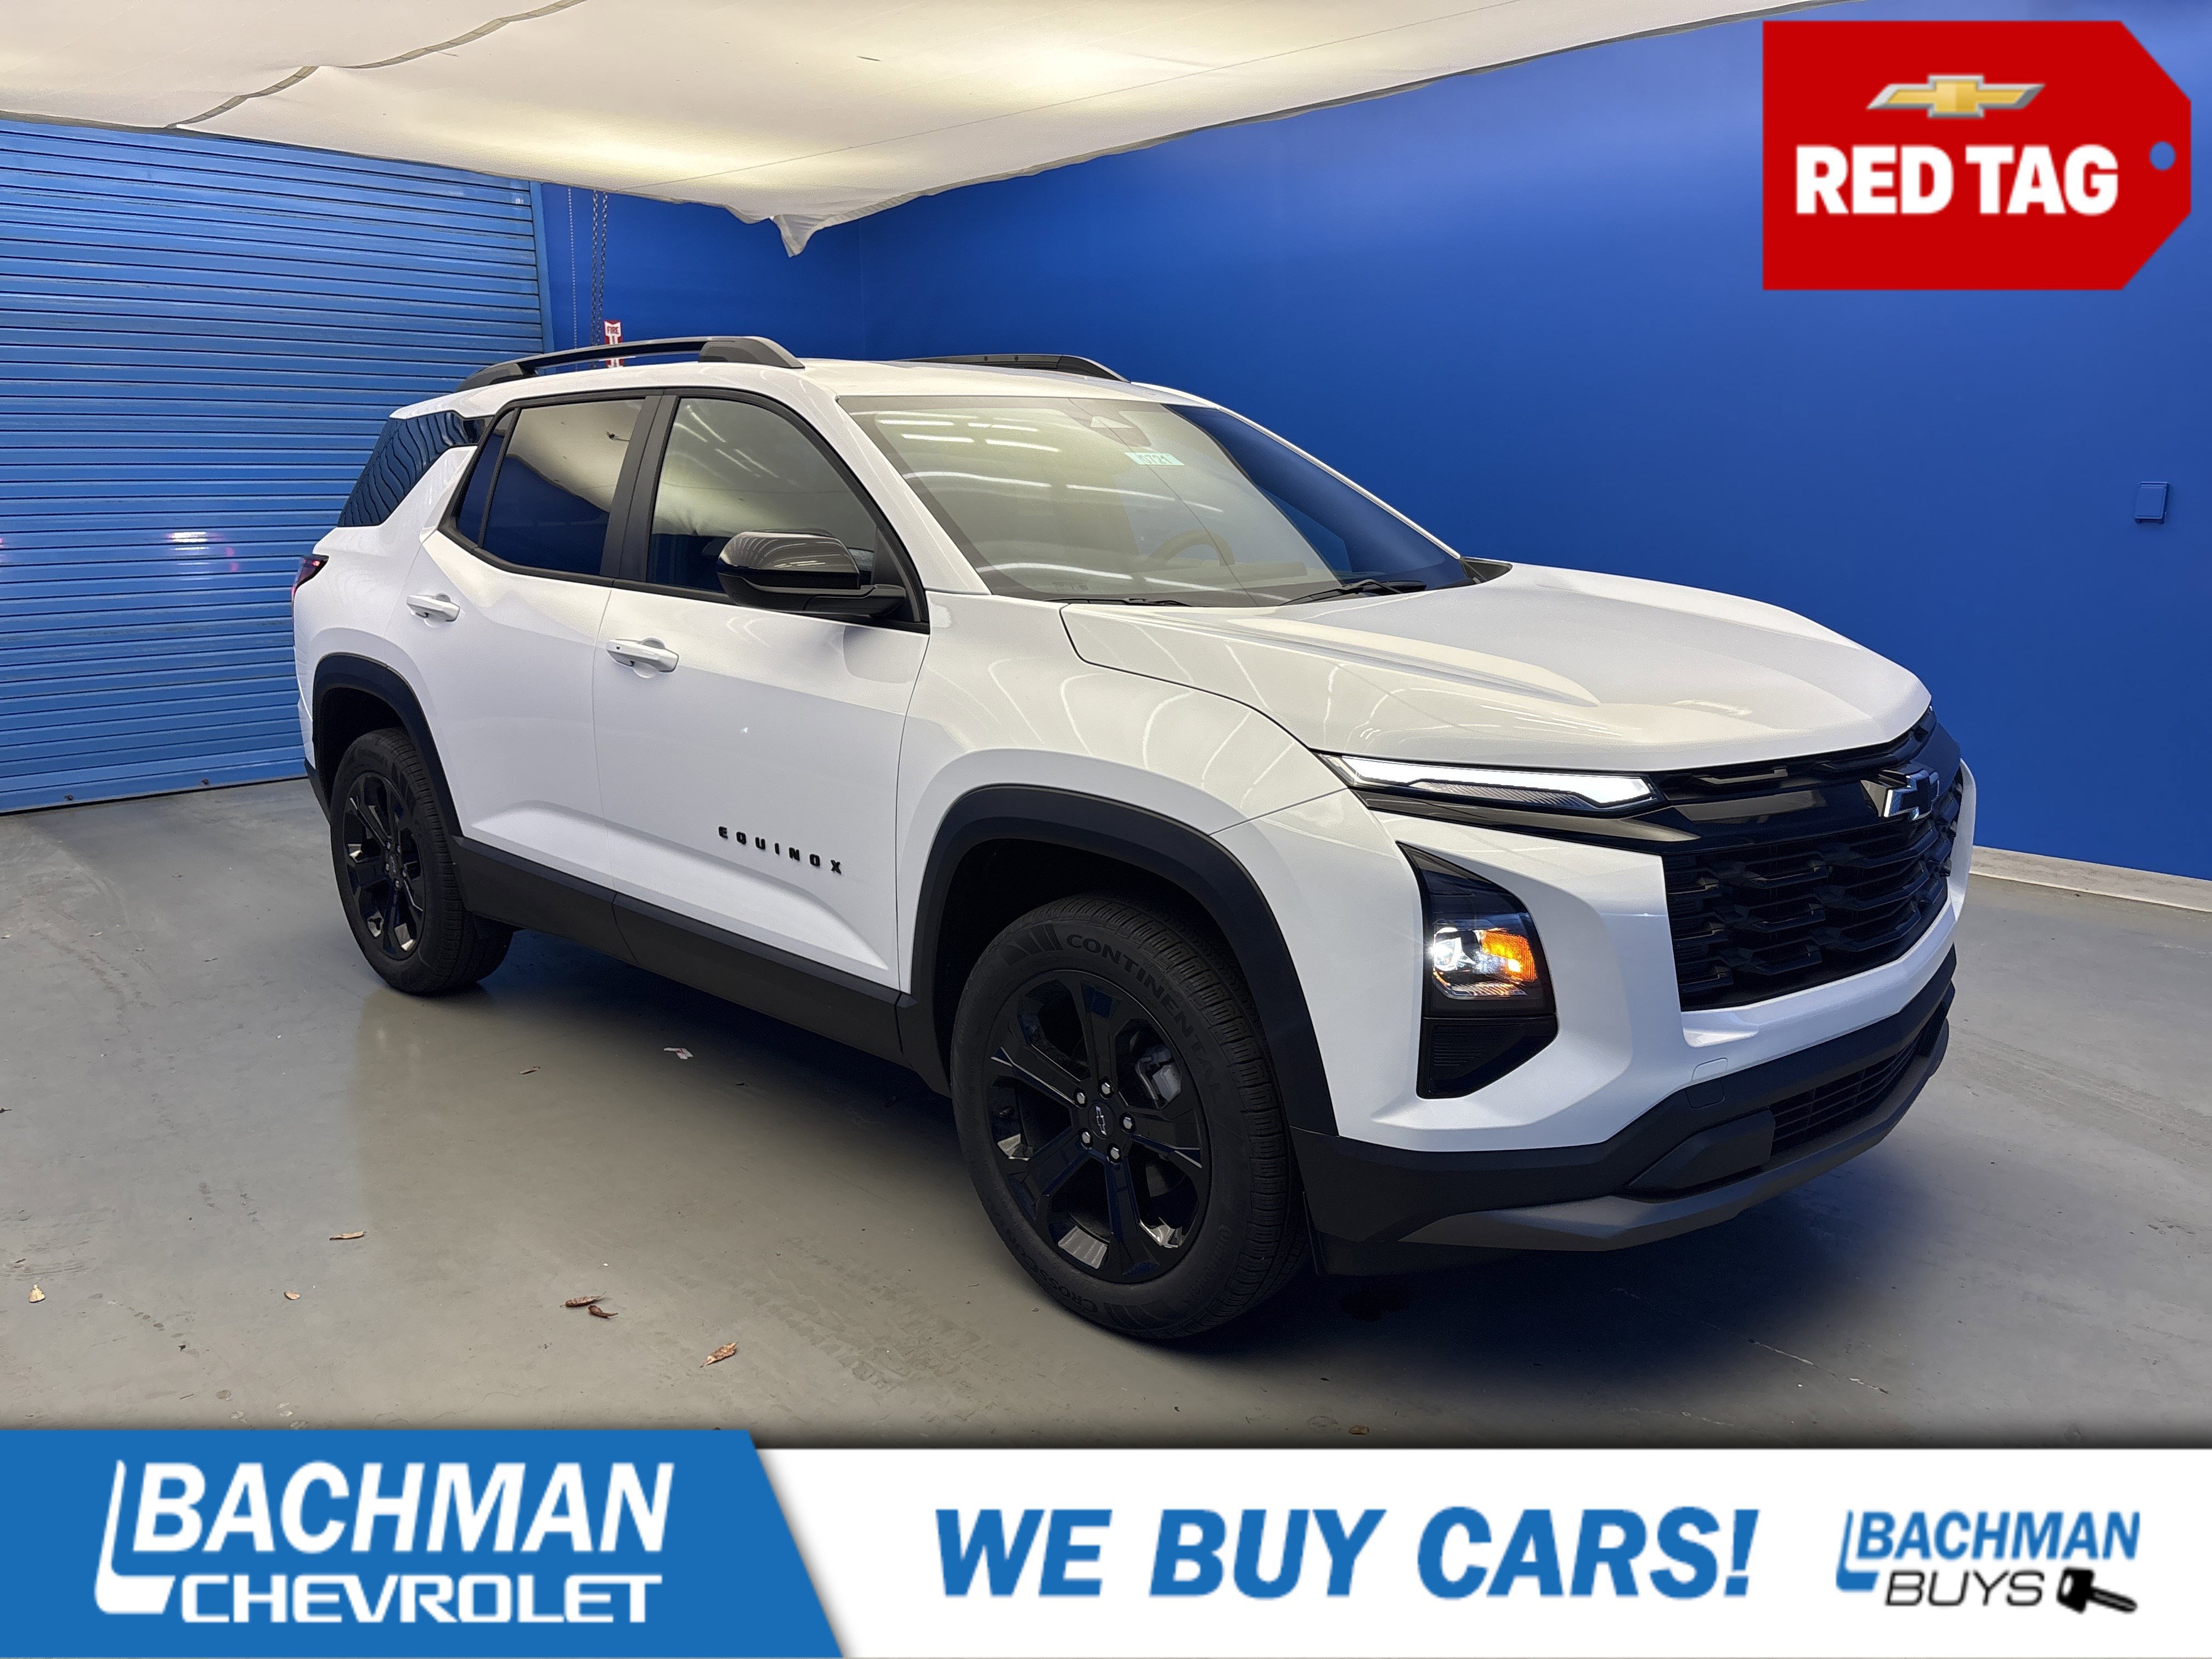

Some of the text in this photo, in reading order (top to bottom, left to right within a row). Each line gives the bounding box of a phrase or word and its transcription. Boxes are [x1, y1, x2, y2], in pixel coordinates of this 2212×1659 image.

[607, 325, 619, 335] FIRE
[718, 826, 842, 874] EQUINOX
[1065, 933, 1228, 1104] CONTINENTAL
